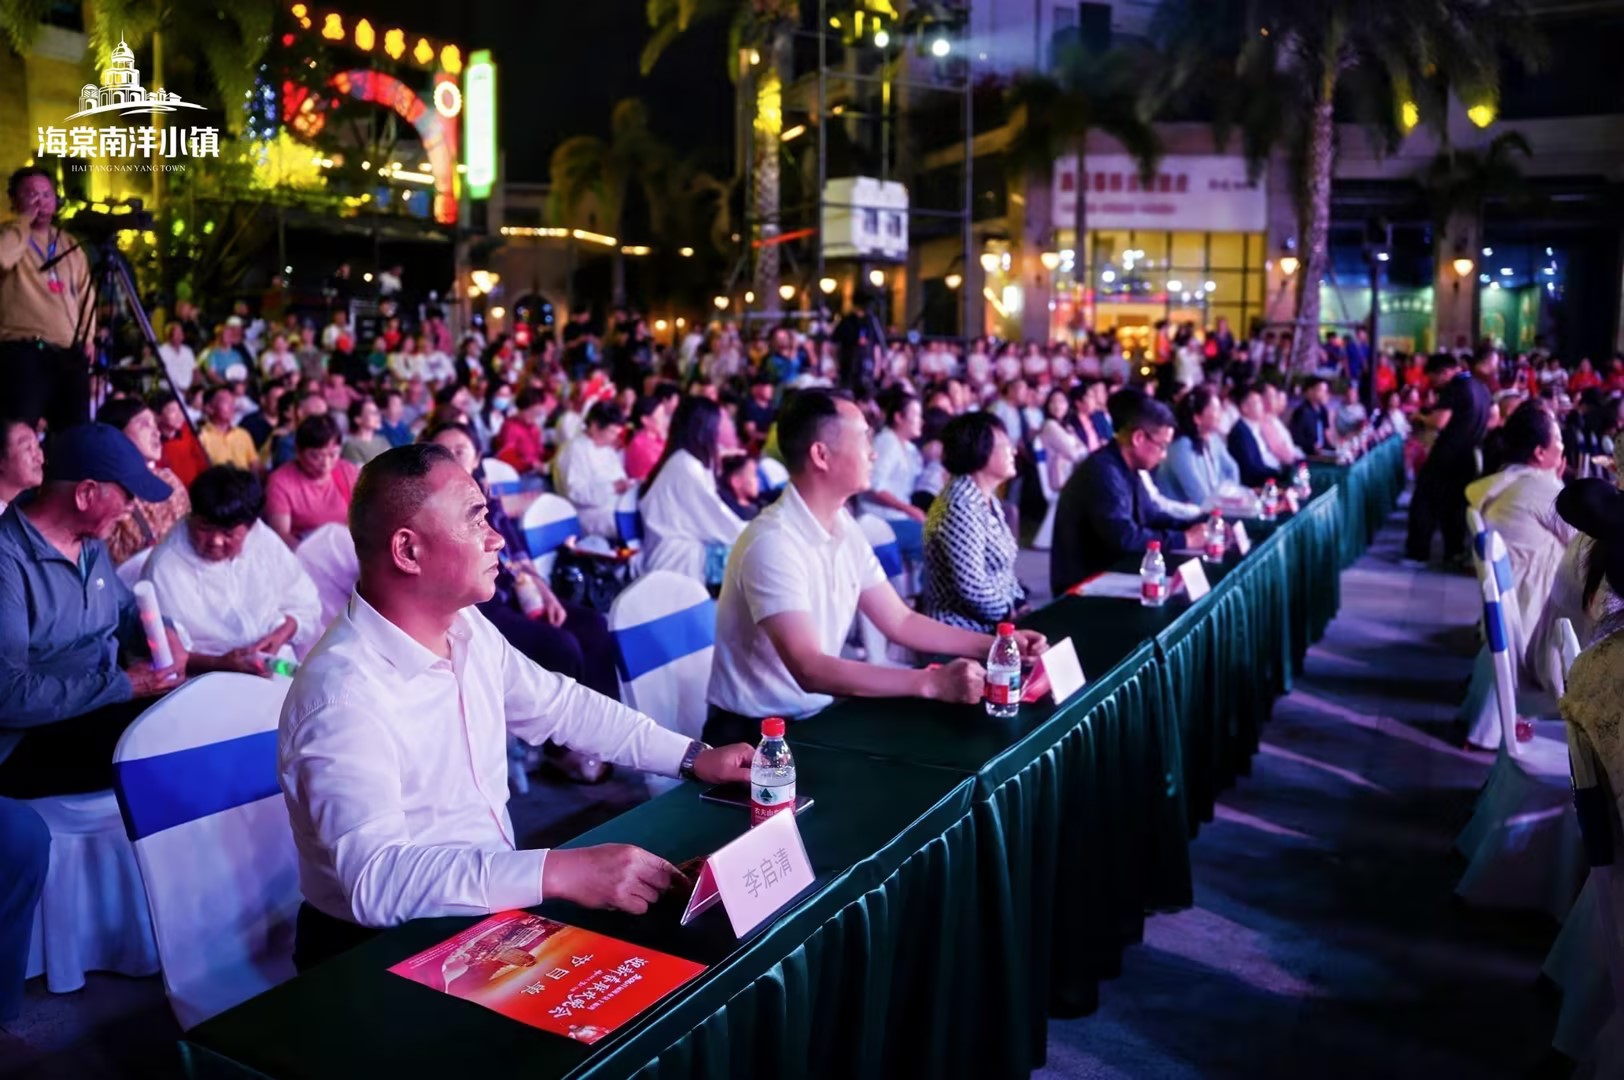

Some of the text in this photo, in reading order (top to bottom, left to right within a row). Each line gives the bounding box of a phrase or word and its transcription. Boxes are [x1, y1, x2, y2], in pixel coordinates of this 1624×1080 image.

[742, 847, 793, 898] 李启清
[521, 954, 594, 995] 节目单
[548, 957, 649, 1019] 迎新春联欢晚会
